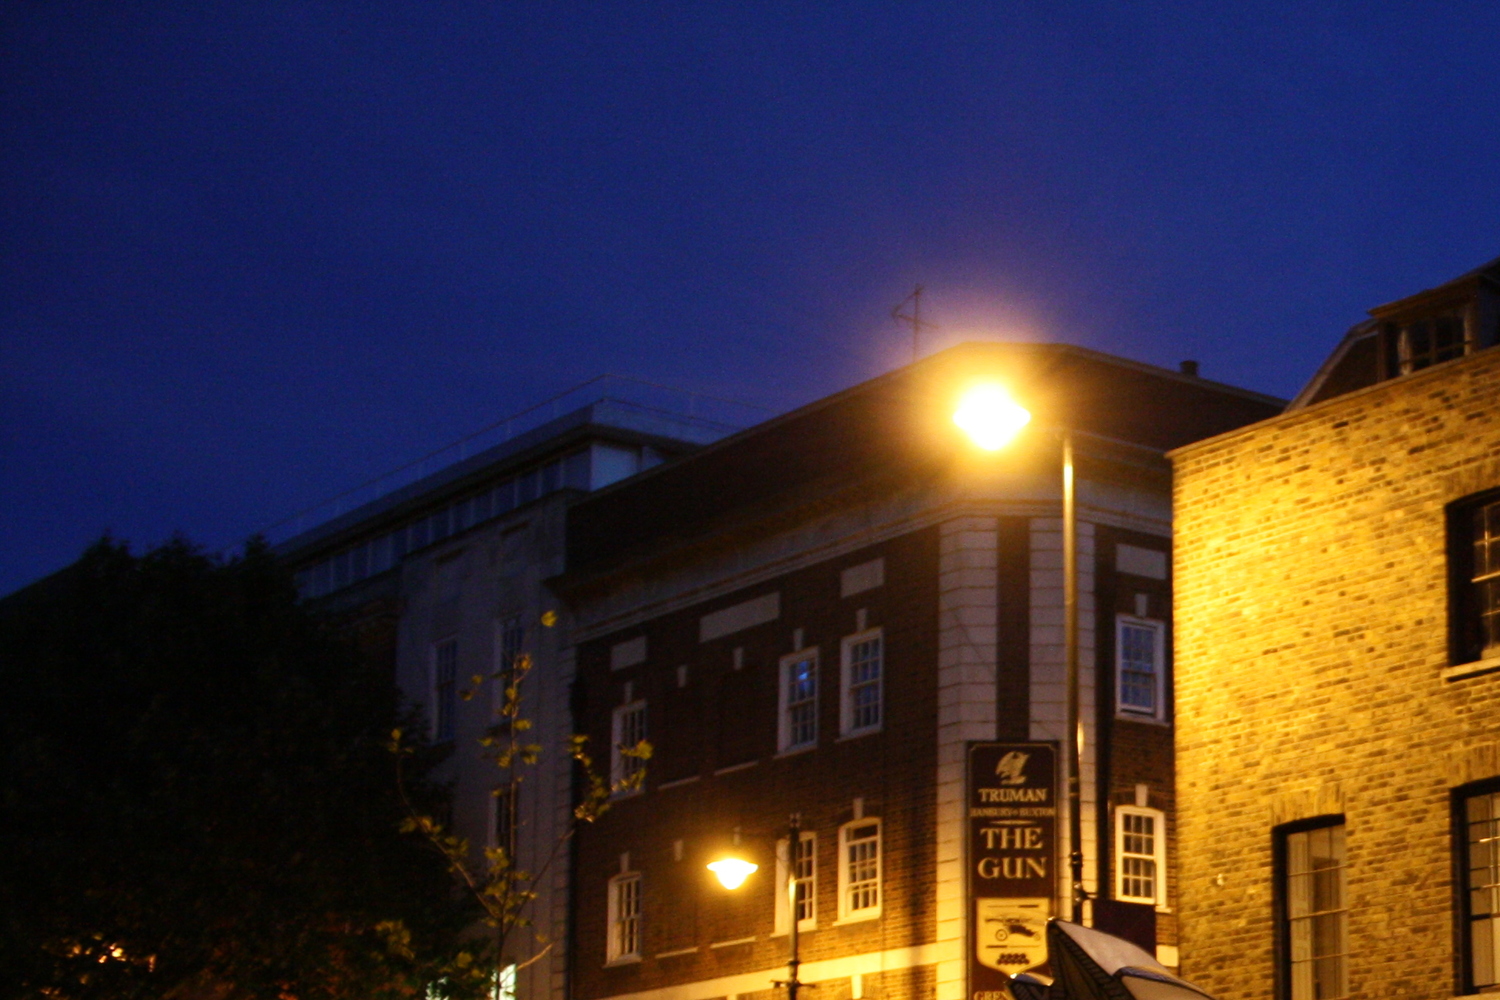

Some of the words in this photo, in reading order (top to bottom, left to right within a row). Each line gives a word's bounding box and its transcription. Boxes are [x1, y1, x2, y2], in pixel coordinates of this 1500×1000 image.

[978, 787, 1048, 802] TRUMAN
[979, 827, 1044, 849] THE
[977, 856, 1048, 879] GUN
